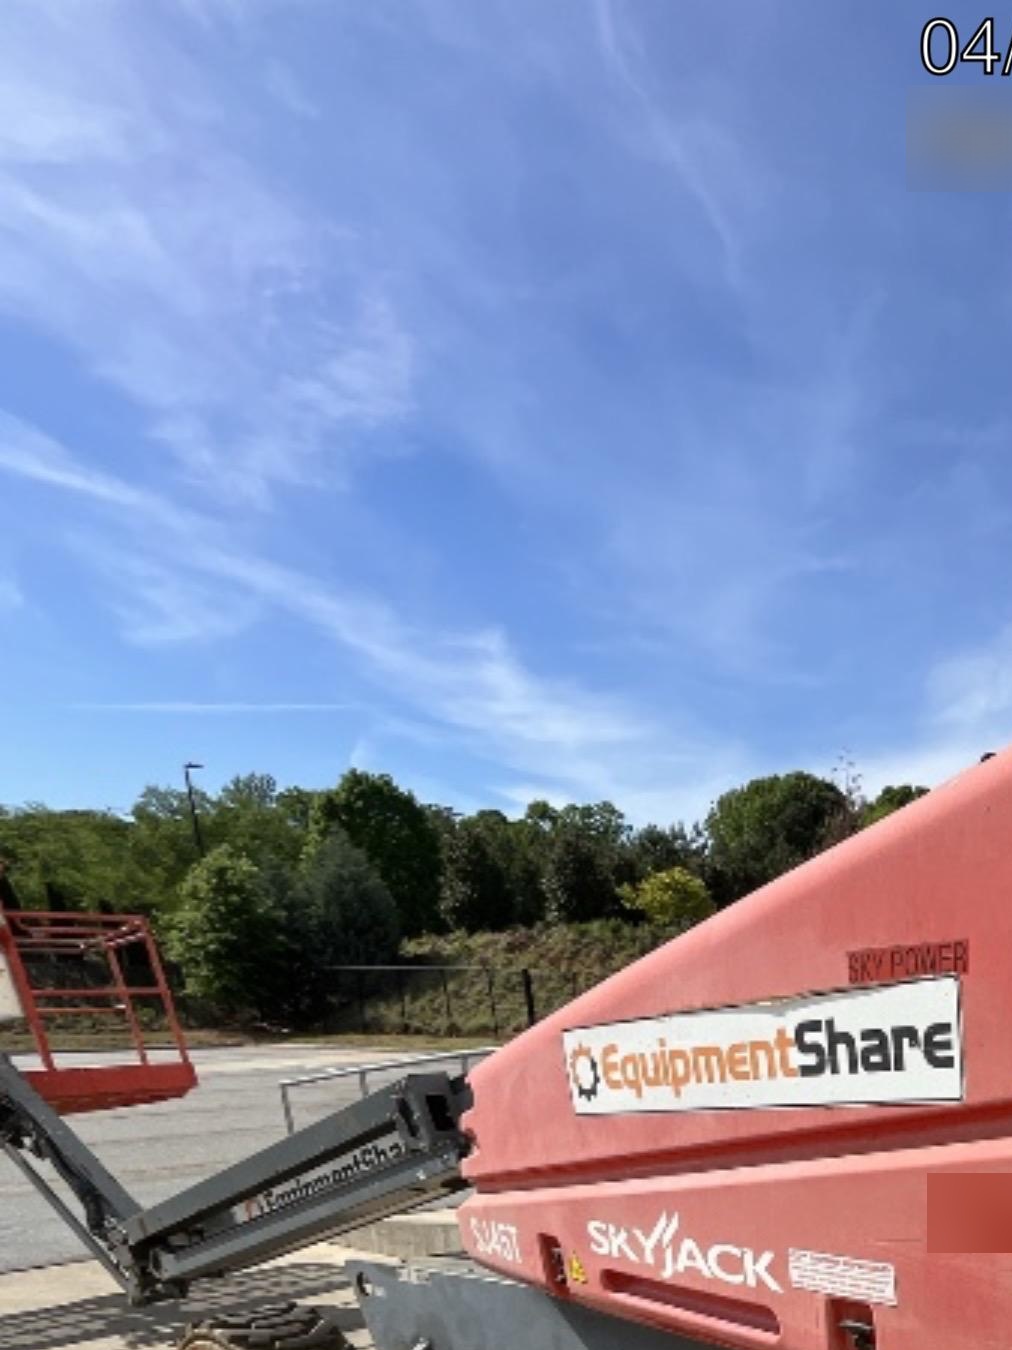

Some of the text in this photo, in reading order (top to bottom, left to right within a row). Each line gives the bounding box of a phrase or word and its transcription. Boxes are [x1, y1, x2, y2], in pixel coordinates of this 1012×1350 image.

[848, 941, 968, 984] SKY POWER
[602, 1017, 954, 1098] EquipmentShare
[587, 1210, 781, 1293] SKYJACK
